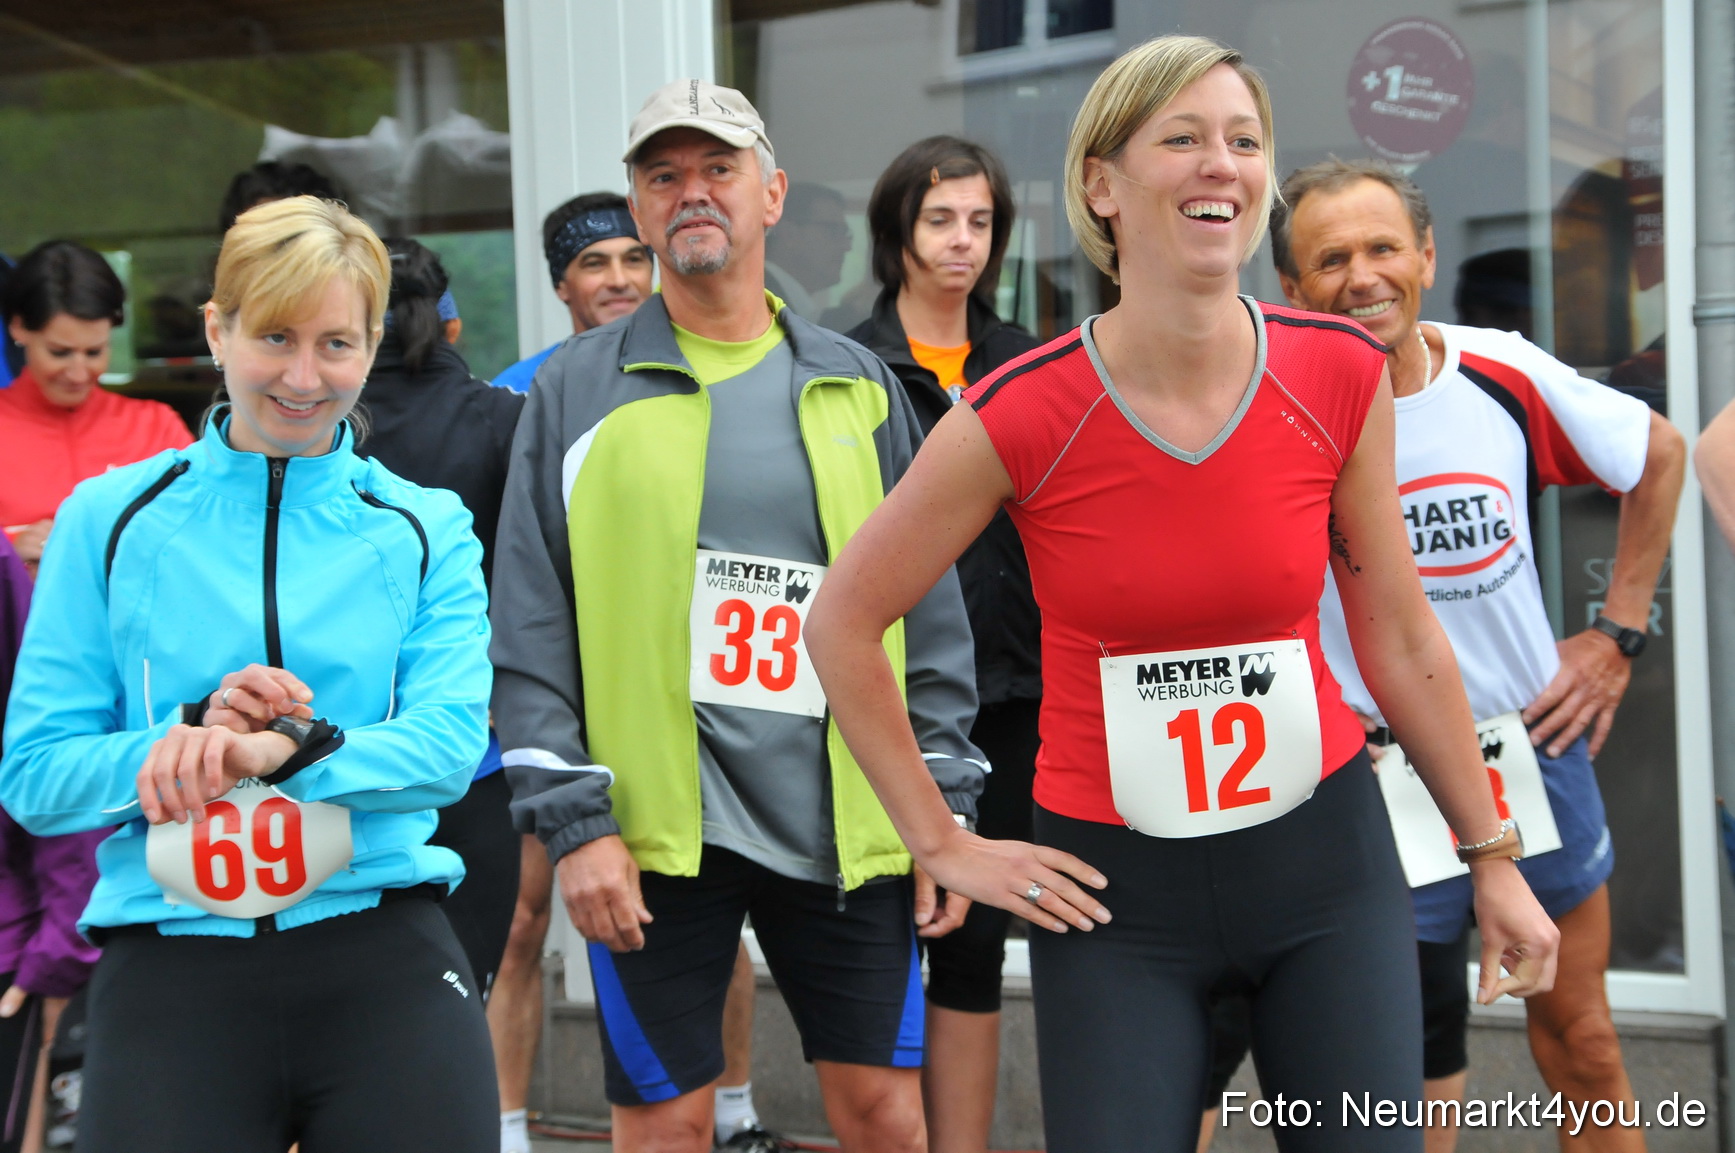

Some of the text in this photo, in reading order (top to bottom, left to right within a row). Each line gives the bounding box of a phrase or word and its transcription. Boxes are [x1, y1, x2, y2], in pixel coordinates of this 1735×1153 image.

[706, 558, 781, 583] MEYER
[706, 576, 780, 597] WERBUNG
[709, 598, 801, 692] 33
[1136, 656, 1233, 686] MEYER
[1137, 679, 1235, 702] WERBUNG
[1166, 702, 1271, 814] 12
[191, 796, 307, 902] 69
